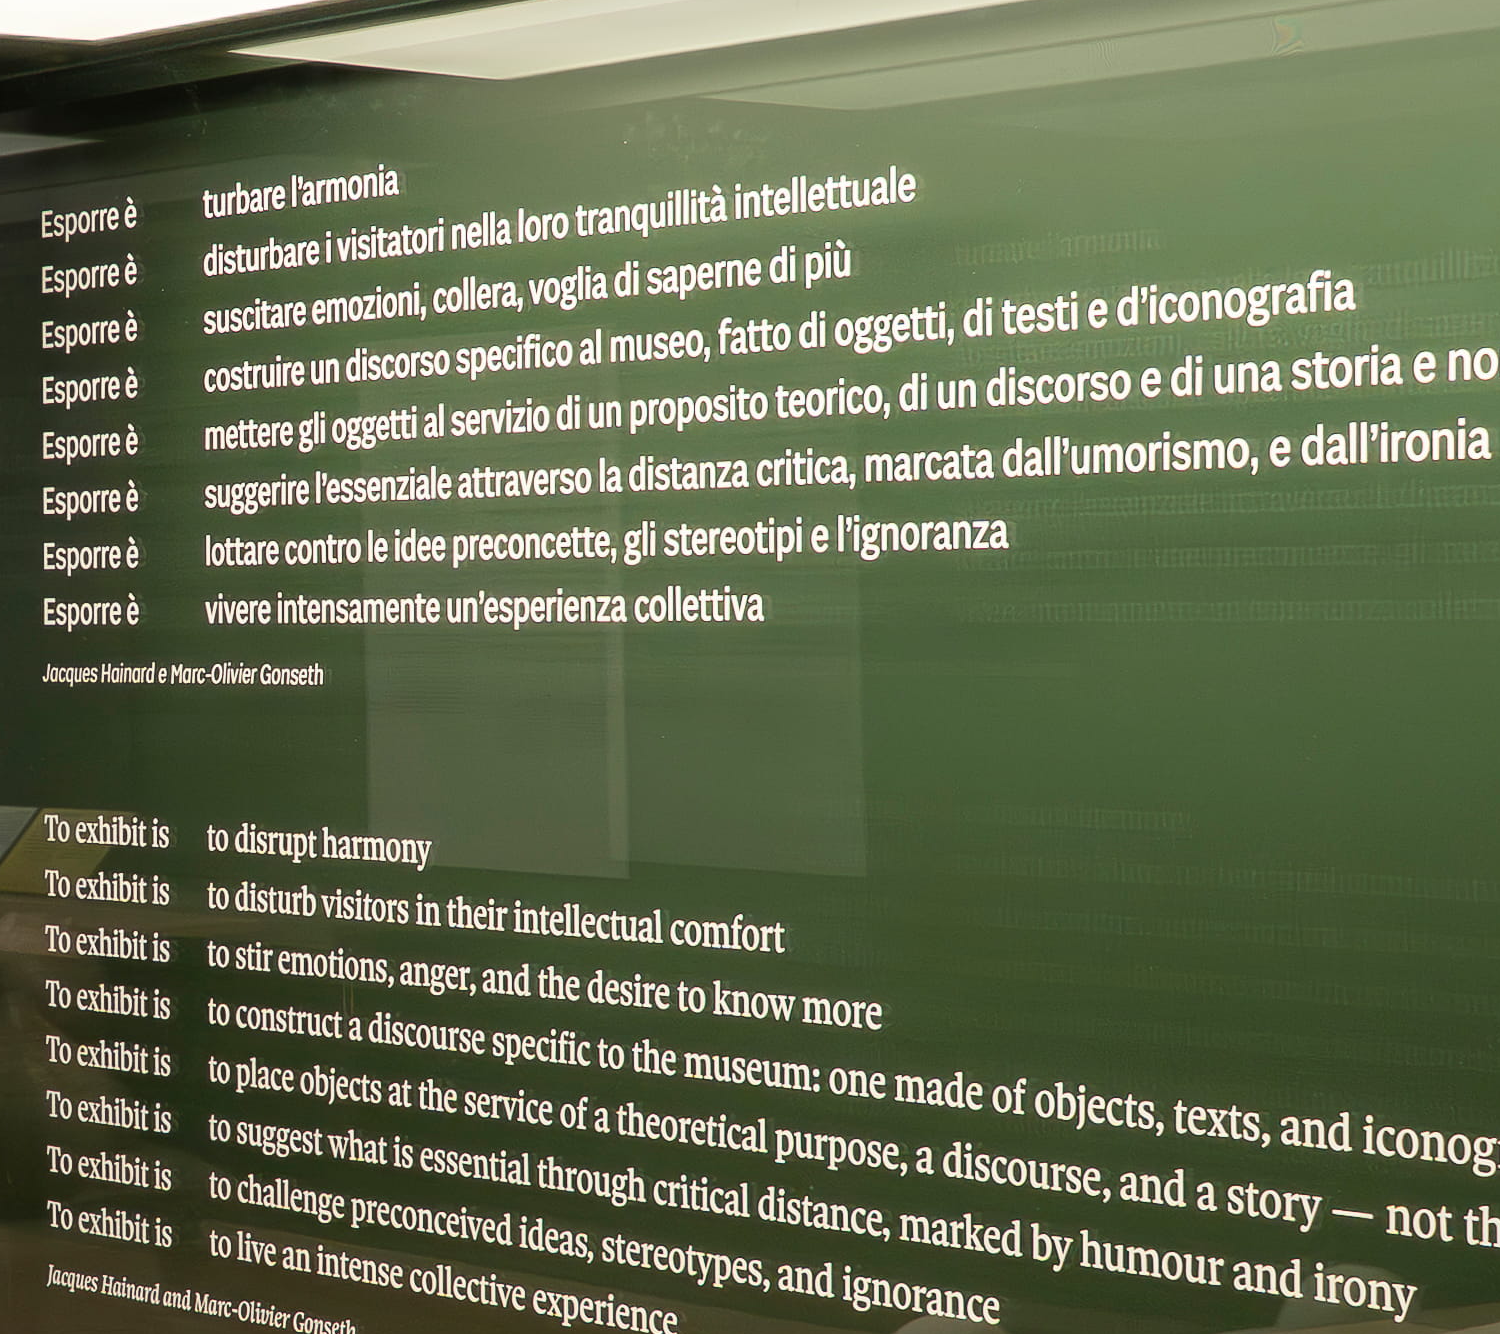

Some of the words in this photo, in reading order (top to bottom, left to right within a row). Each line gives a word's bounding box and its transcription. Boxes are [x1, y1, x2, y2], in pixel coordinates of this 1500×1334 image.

[41, 206, 120, 243] Esporre
[123, 195, 138, 229] è
[202, 181, 286, 219] turbare
[291, 163, 400, 208] l’armonia
[41, 319, 121, 355] Esporre
[124, 309, 138, 342] è
[203, 297, 307, 335] suscitare
[311, 281, 427, 325] emozioni,
[432, 275, 524, 314] collera,
[528, 265, 609, 311] voglia
[613, 260, 640, 298] di
[646, 257, 762, 301] saperne
[769, 245, 796, 284] di
[805, 238, 851, 290] più
[42, 431, 121, 466] Esporre
[125, 423, 139, 456] è
[204, 418, 294, 451] mettere
[298, 410, 326, 454] gli
[331, 405, 418, 451] oggetti
[423, 402, 445, 439] al
[450, 397, 551, 437] servizio
[556, 394, 581, 431] di
[588, 400, 622, 429] un
[629, 384, 769, 435] proposito
[774, 377, 891, 420] teorico,
[898, 372, 928, 412] di
[937, 378, 977, 410] un
[986, 366, 1132, 407] discorso
[1140, 367, 1162, 398] e
[1170, 354, 1203, 397] di
[1214, 360, 1283, 395] una
[1290, 343, 1404, 390] storia
[1413, 351, 1437, 384] e
[42, 486, 122, 522] Esporre
[125, 478, 139, 513] è
[204, 472, 310, 516] suggerire
[315, 465, 453, 504] l’essenziale
[457, 466, 593, 499] attraverso
[599, 457, 624, 493] la
[628, 455, 750, 492] distanza
[756, 447, 857, 490] critica,
[865, 444, 995, 483] marcata
[1002, 430, 1259, 478] dall’umorismo,
[1269, 435, 1292, 468] e
[1301, 417, 1492, 467] dall’ironia
[43, 542, 122, 577] Esporre
[125, 535, 140, 569] è
[205, 534, 280, 567] lottare
[284, 533, 362, 566] contro
[367, 529, 389, 563] le
[394, 527, 447, 563] idee
[452, 526, 617, 569] preconcette,
[623, 520, 657, 566] gli
[663, 516, 803, 562] stereotipi
[810, 524, 830, 554] e
[837, 514, 1010, 561] l’ignoranza
[43, 597, 122, 633] Esporre
[126, 592, 140, 626] è
[204, 592, 272, 625] vivere
[277, 591, 441, 625] intensamente
[446, 587, 628, 631] un’esperienza
[634, 585, 765, 624] collettiva
[41, 662, 99, 688] Jacques
[100, 661, 156, 684] Hainard
[157, 667, 168, 684] e
[170, 661, 259, 685] Marc-Olivier
[259, 662, 324, 686] Gonseth
[43, 813, 71, 843] To
[74, 814, 148, 848] exhibit
[151, 817, 170, 849] is
[206, 824, 229, 852] to
[234, 822, 318, 864] disrupt
[321, 826, 433, 872] harmony
[44, 924, 72, 954] To
[75, 927, 148, 961] exhibit
[151, 931, 171, 963] is
[206, 940, 230, 969] to
[235, 941, 274, 973] stir
[277, 947, 395, 989] emotions,
[399, 961, 477, 997] anger,
[481, 963, 532, 997] and
[537, 965, 581, 1002] the
[586, 969, 671, 1010] desire
[676, 980, 707, 1014] to
[712, 979, 797, 1022] know
[801, 996, 883, 1031] more
[45, 1034, 72, 1065] To
[76, 1039, 149, 1075] exhibit
[152, 1046, 172, 1077] is
[207, 1055, 231, 1085] to
[235, 1056, 295, 1094] place
[299, 1064, 383, 1105] objects
[387, 1079, 413, 1108] at
[417, 1078, 458, 1114] the
[463, 1089, 553, 1126] service
[559, 1096, 589, 1131] of
[593, 1107, 611, 1134] a
[615, 1101, 769, 1154] theoretical
[774, 1129, 908, 1177] purpose,
[915, 1146, 935, 1176] a
[942, 1141, 1112, 1204] discourse,
[1119, 1168, 1187, 1208] and
[1196, 1181, 1218, 1212] a
[1227, 1182, 1323, 1233] story
[1385, 1204, 1454, 1243] not
[46, 1144, 73, 1176] To
[77, 1151, 150, 1188] exhibit
[153, 1159, 172, 1192] is
[208, 1171, 232, 1201] to
[236, 1173, 345, 1224] challenge
[350, 1197, 514, 1247] preconceived
[518, 1215, 595, 1264] ideas,
[601, 1233, 771, 1293] stereotypes,
[777, 1261, 836, 1299] and
[842, 1264, 1001, 1325] ignorance
[46, 1199, 74, 1231] To
[77, 1206, 150, 1245] exhibit
[154, 1217, 173, 1248] is
[208, 1229, 232, 1259] to
[236, 1230, 277, 1267] live
[281, 1246, 312, 1273] an
[316, 1244, 404, 1289] intense
[409, 1264, 526, 1312] collective
[46, 1263, 99, 1293] Jacques
[100, 1274, 161, 1305] Hainard
[162, 1289, 192, 1312] and
[194, 1291, 292, 1329] Marc-Olivier
